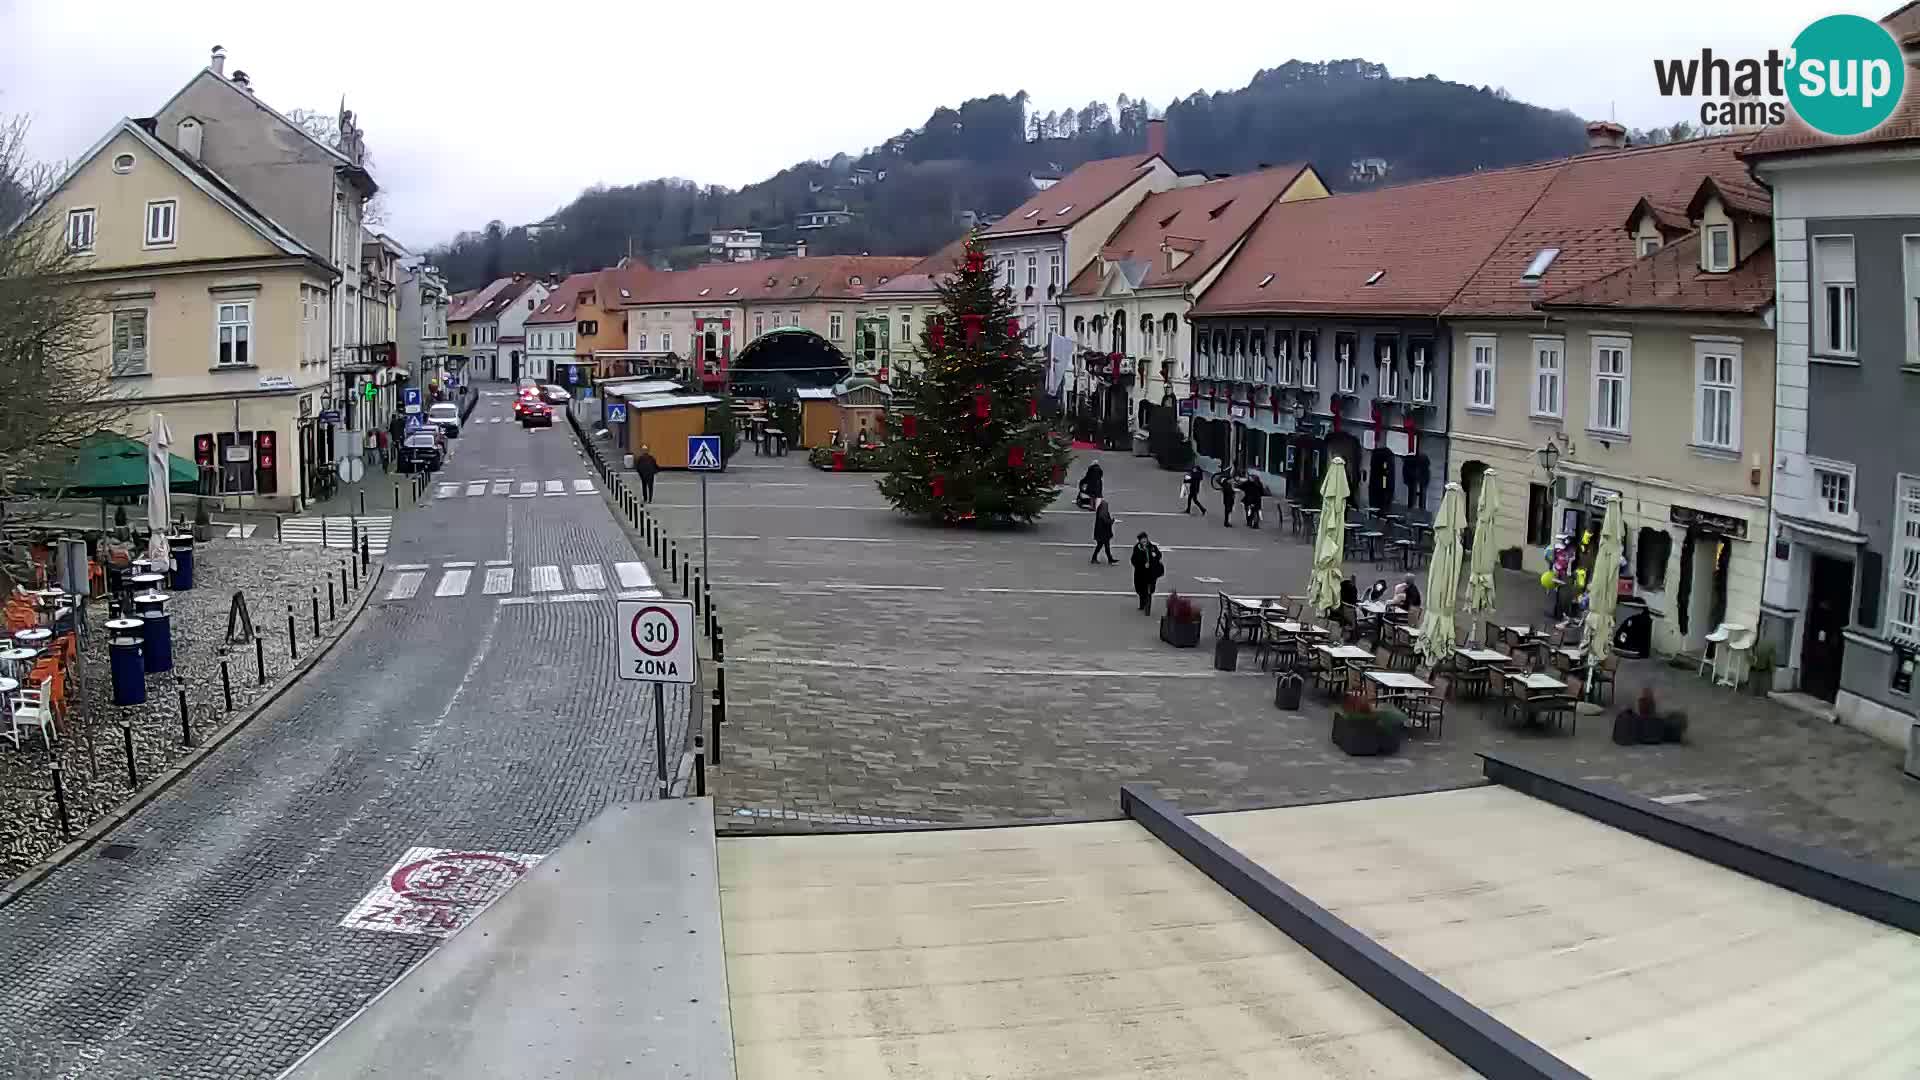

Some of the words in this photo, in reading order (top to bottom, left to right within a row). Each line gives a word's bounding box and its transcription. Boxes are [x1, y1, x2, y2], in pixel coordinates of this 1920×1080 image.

[409, 392, 416, 403] P
[644, 622, 668, 643] 30
[634, 659, 678, 676] ZONA
